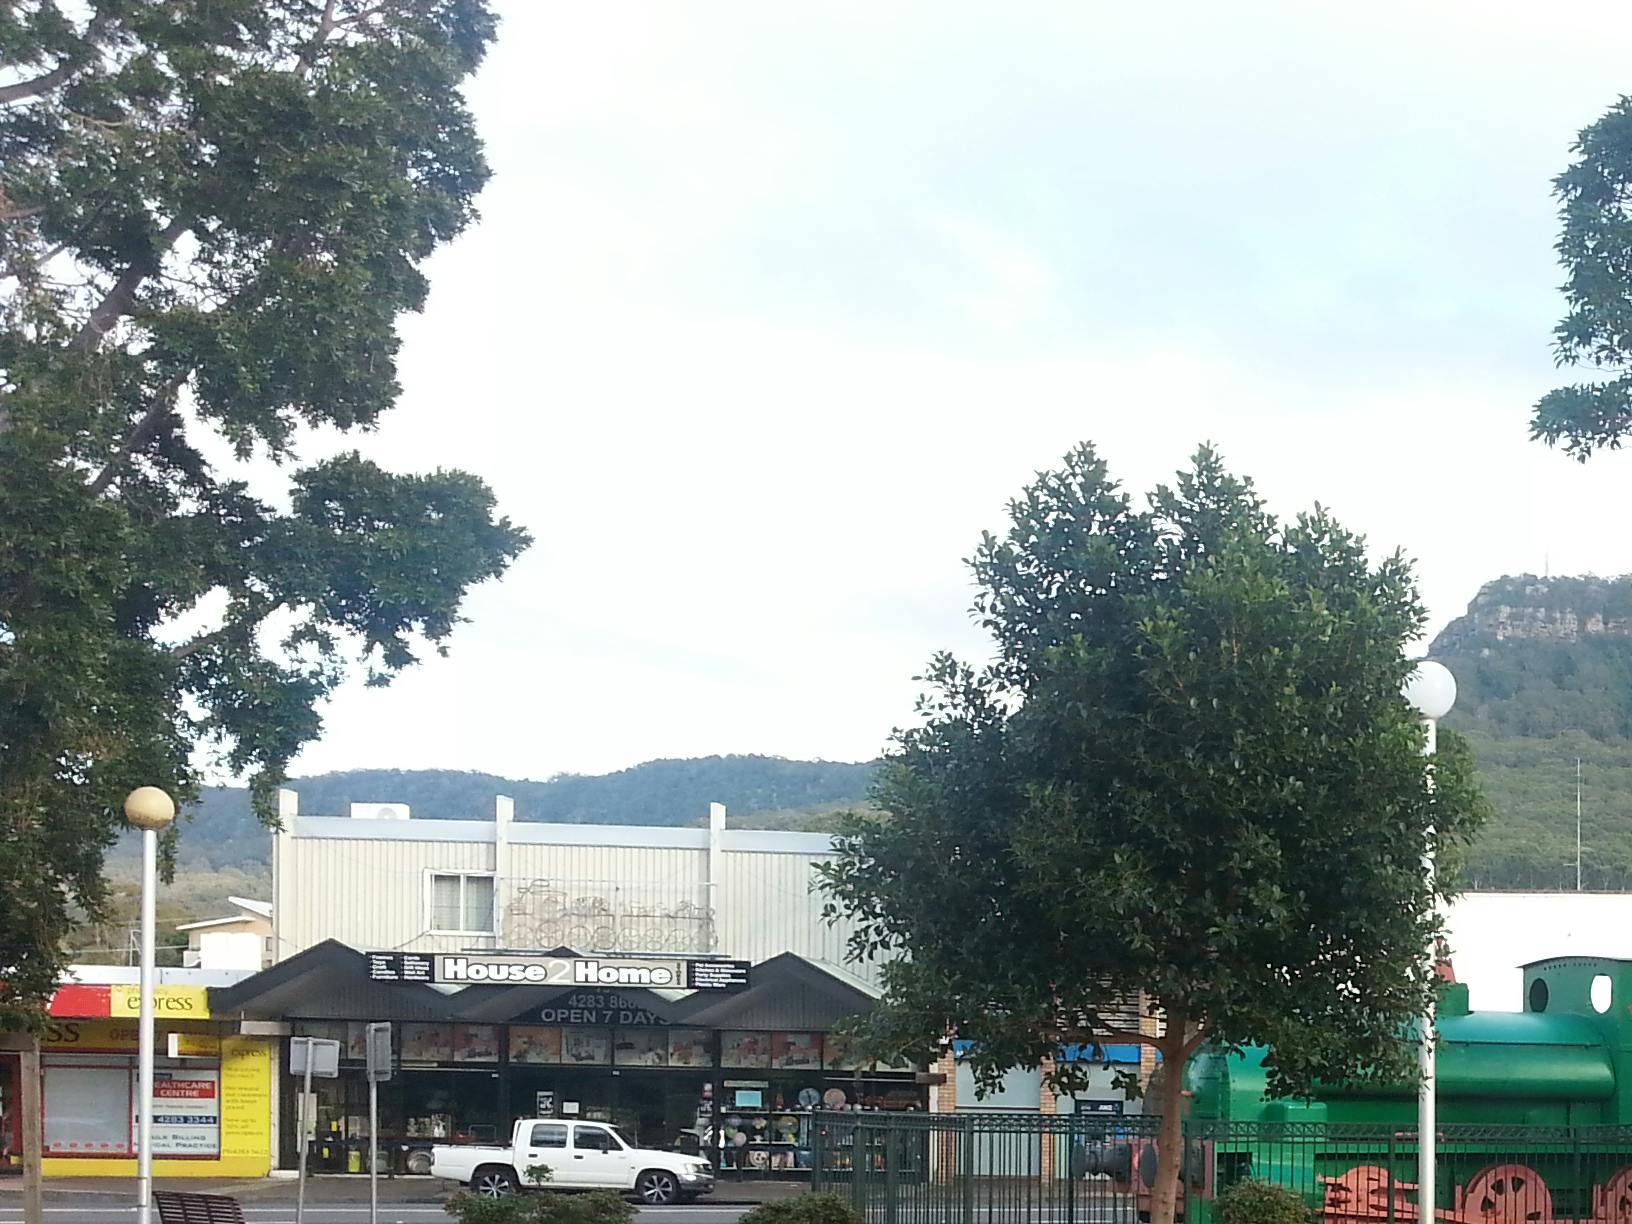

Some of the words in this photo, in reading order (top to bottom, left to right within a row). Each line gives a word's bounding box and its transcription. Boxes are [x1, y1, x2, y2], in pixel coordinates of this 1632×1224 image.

[443, 957, 547, 982] House
[548, 958, 571, 984] 2
[574, 960, 673, 985] Home
[127, 995, 193, 1011] eress
[568, 995, 604, 1008] 4283
[541, 1009, 596, 1023] OPEN
[602, 1010, 613, 1023] 7
[109, 1028, 140, 1042] OPE
[154, 1081, 212, 1089] EALTHCARE
[160, 1089, 200, 1097] CENTRE
